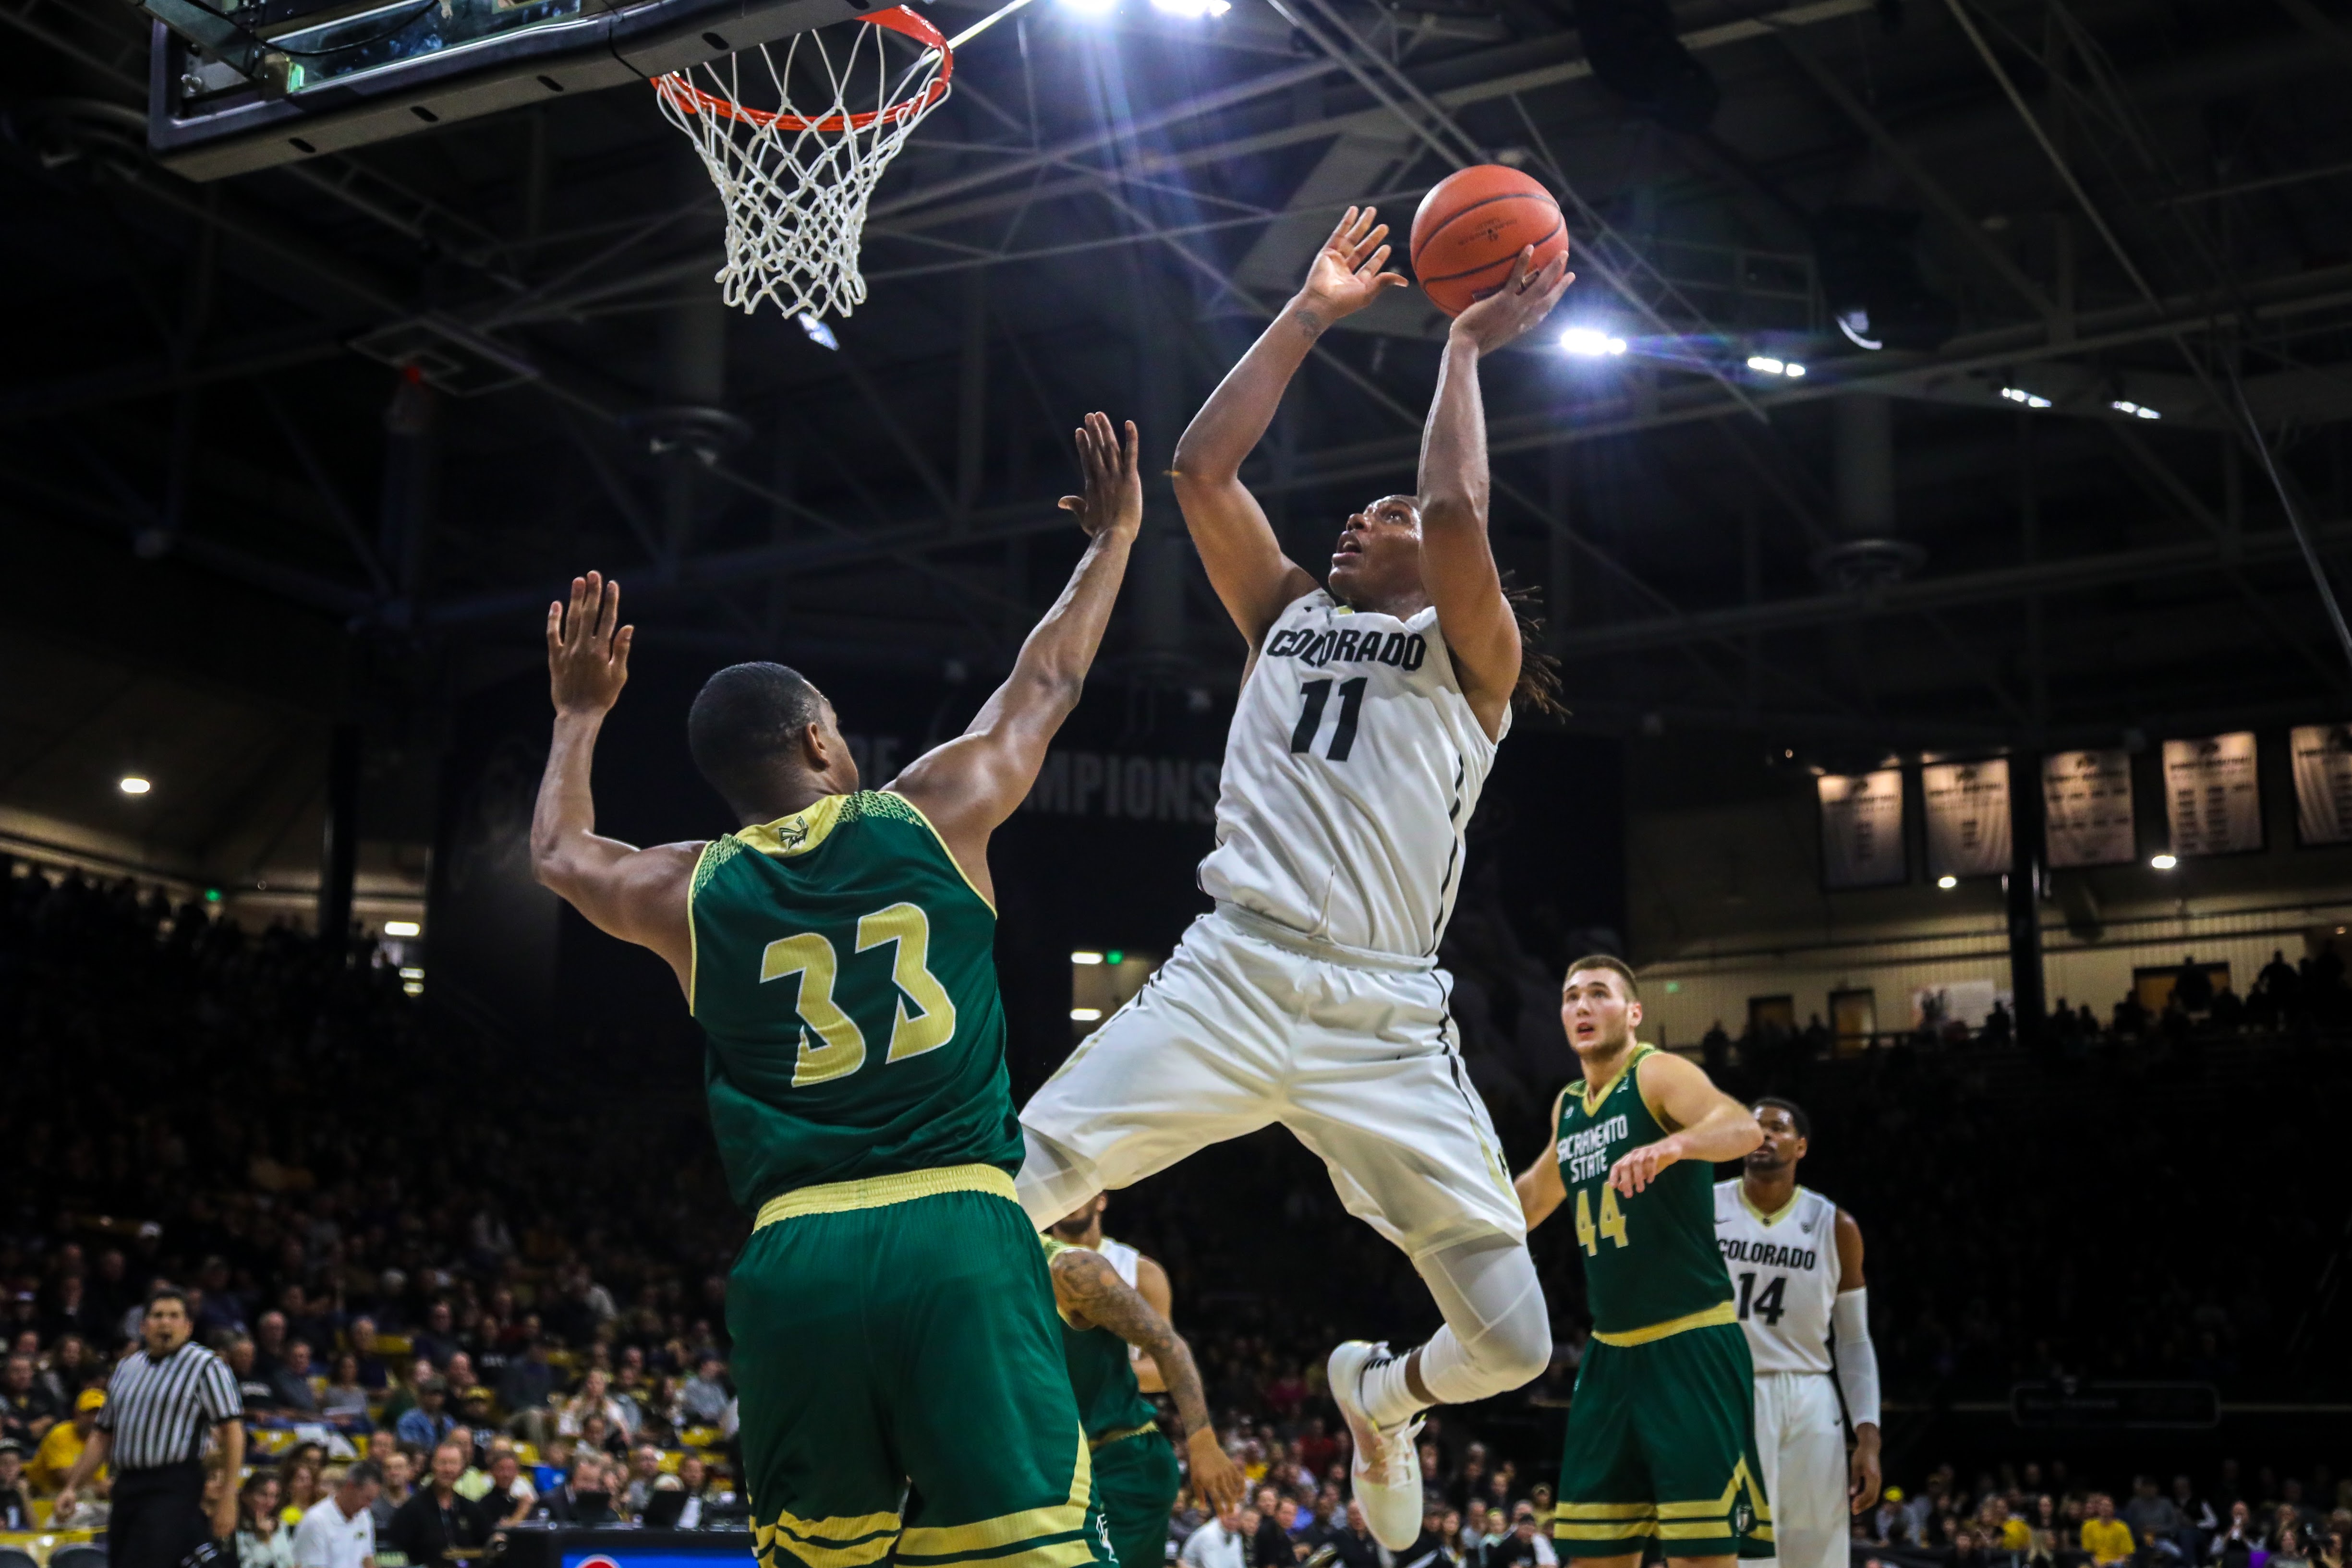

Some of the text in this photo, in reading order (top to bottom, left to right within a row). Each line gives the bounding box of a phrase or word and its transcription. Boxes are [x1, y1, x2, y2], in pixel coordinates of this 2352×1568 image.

[1266, 629, 1426, 671] COLORADO
[1291, 677, 1368, 762] 11
[1020, 749, 1220, 824] MPIONS
[759, 901, 957, 1088] 33
[1556, 1113, 1629, 1164] SACRAMENTO
[1569, 1146, 1609, 1184] STATE
[1575, 1181, 1630, 1257] 44
[1718, 1238, 1817, 1271] COLORADO
[1738, 1271, 1787, 1326] 14
